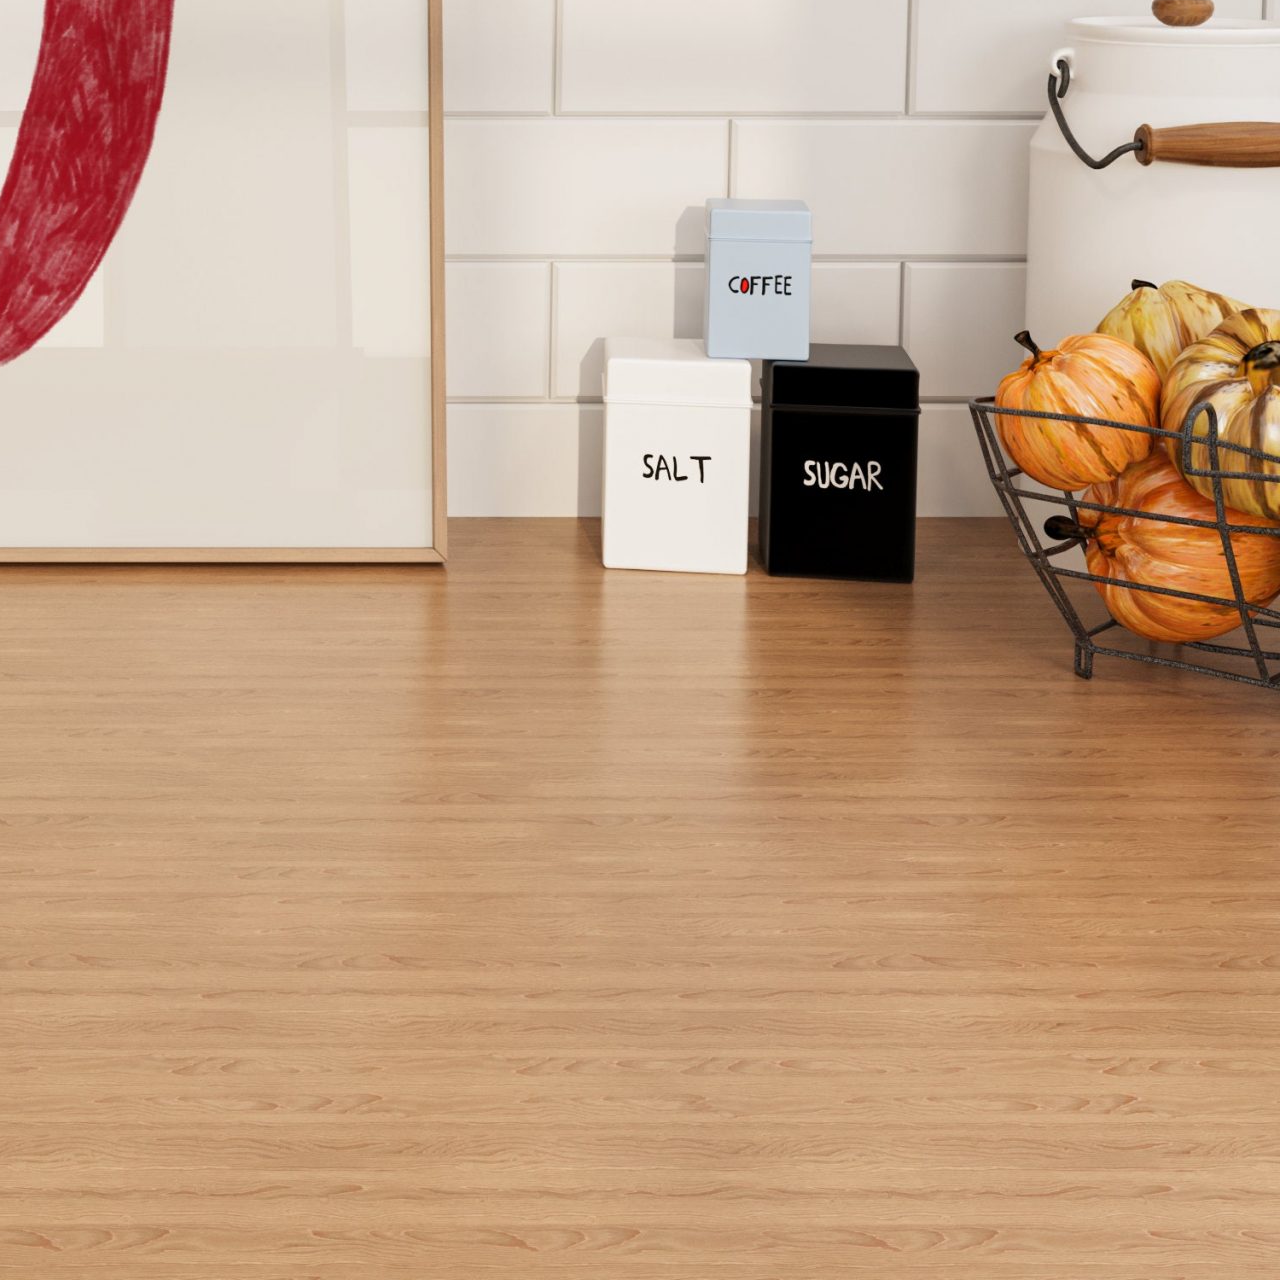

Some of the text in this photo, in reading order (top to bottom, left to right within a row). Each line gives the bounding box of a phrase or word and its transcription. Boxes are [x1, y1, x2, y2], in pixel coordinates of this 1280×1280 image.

[728, 274, 793, 296] COFFEE
[642, 453, 712, 484] SALT
[803, 460, 884, 491] SUGAR
